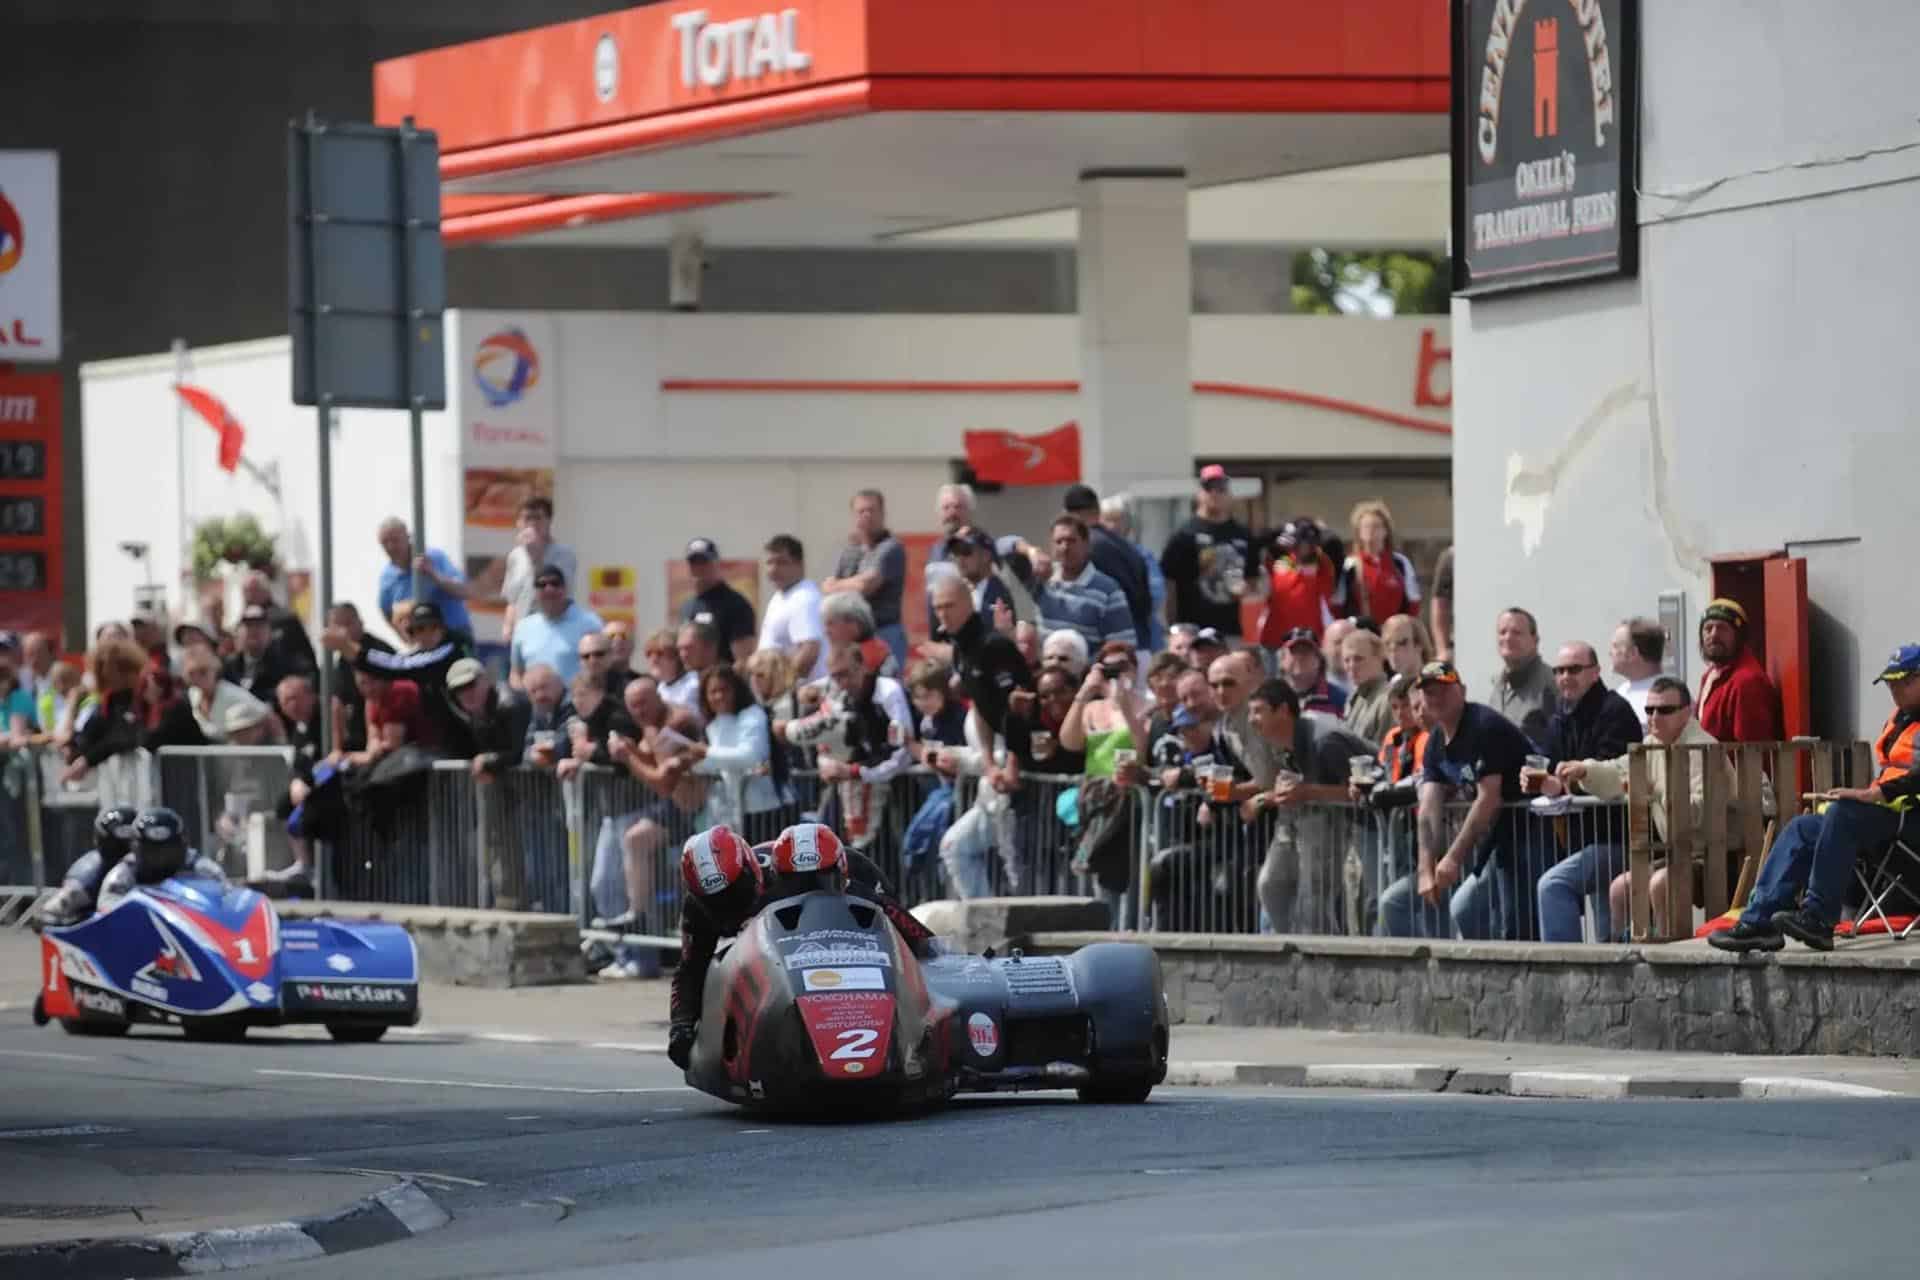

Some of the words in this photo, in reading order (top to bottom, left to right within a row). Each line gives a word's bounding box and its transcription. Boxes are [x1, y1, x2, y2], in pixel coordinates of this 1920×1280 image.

[671, 9, 812, 88] TOTAL
[1473, 199, 1571, 251] TRADITIONAL
[232, 938, 259, 964] 1
[48, 954, 59, 992] 1
[296, 983, 406, 1002] PokerStars
[802, 992, 889, 1003] YOKOHAMA
[829, 1028, 880, 1060] 2
